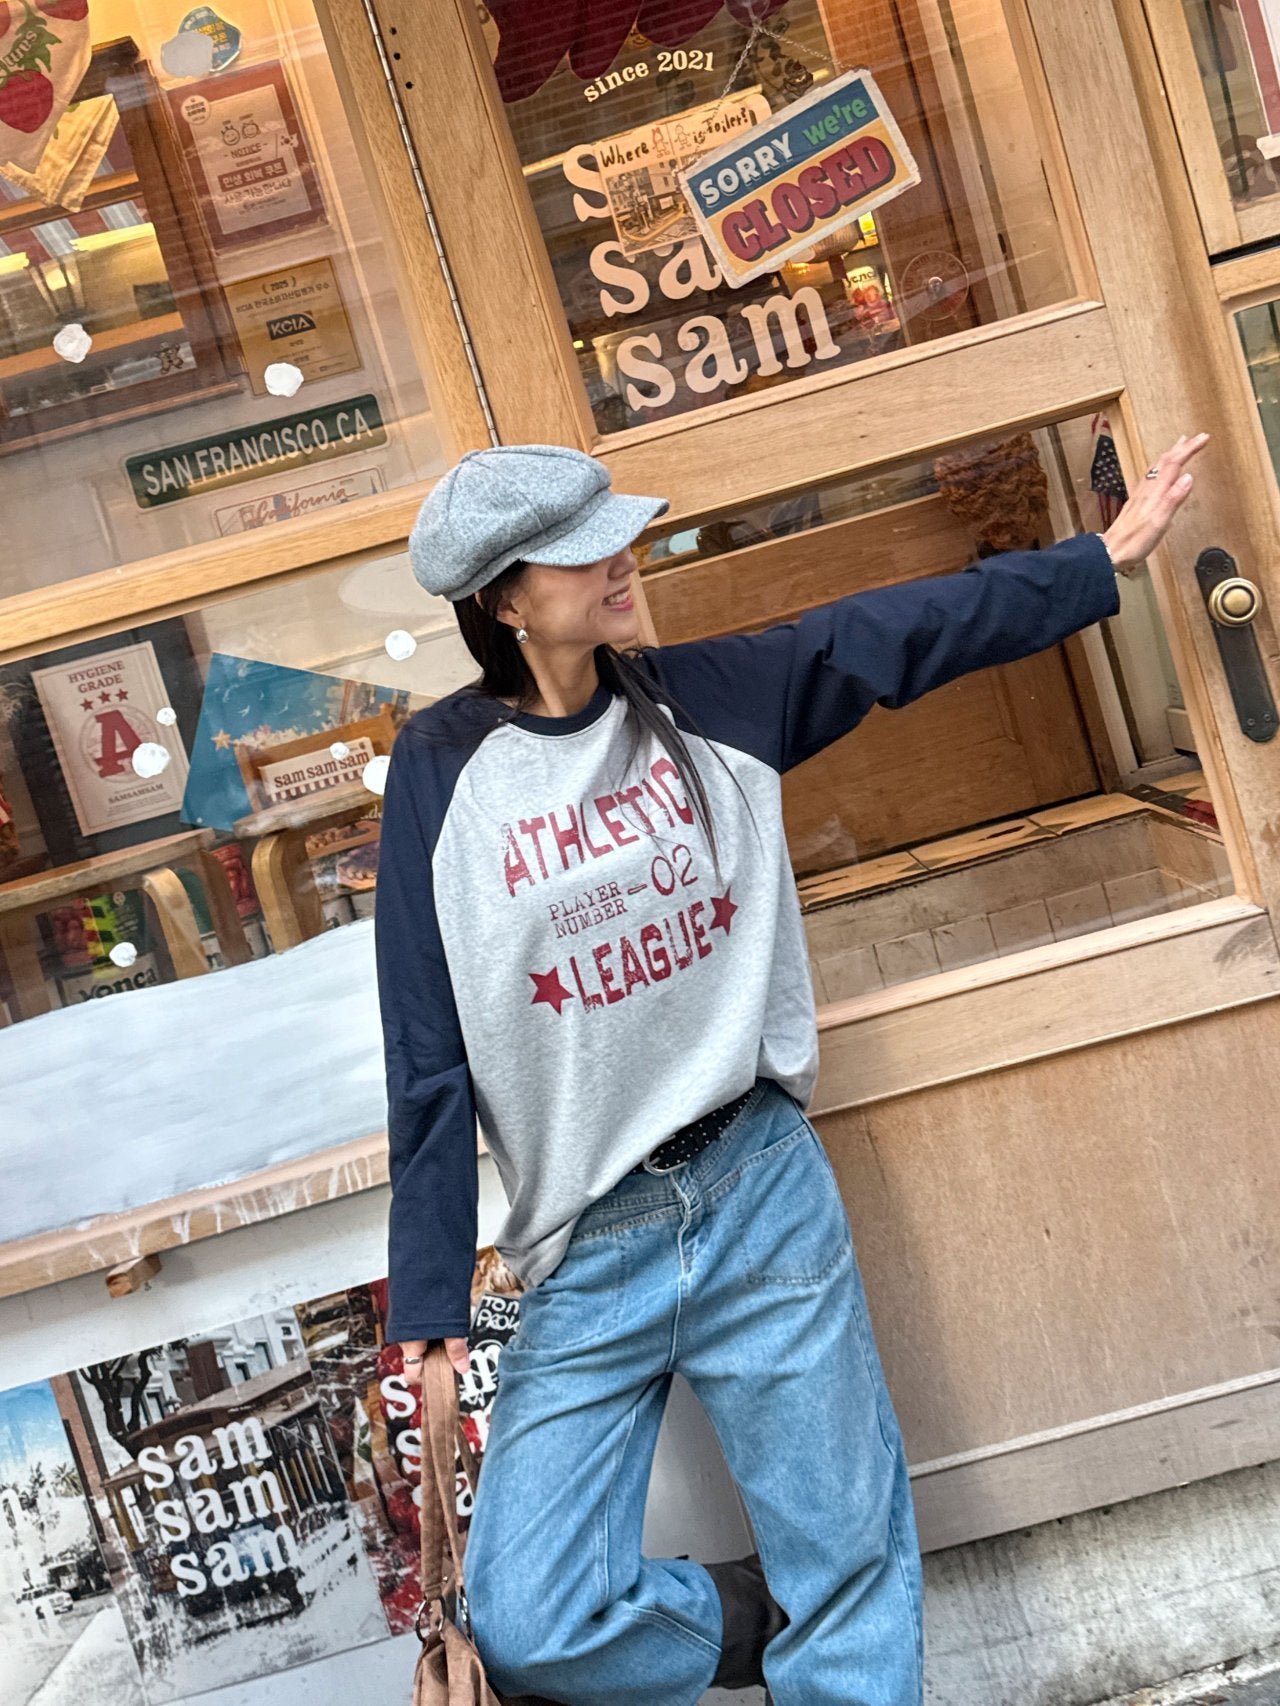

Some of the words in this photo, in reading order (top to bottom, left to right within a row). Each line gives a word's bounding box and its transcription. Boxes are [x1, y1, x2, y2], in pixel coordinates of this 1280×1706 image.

[583, 62, 649, 102] since
[656, 50, 714, 72] 2021
[230, 142, 262, 159] NOTICE
[600, 142, 650, 168] Where
[699, 132, 793, 208] SORRY
[802, 98, 868, 146] we're
[721, 136, 896, 262] CLOSED
[589, 238, 816, 318] sa
[269, 316, 312, 337] KCIA
[616, 286, 841, 412] sam
[142, 455, 194, 496] SAN
[196, 418, 337, 482] FRANCISCO,
[336, 408, 374, 443] CA
[253, 484, 359, 522] California
[67, 660, 125, 684] HYGIENE
[77, 674, 123, 694] GRADE
[94, 709, 143, 779] A
[107, 783, 164, 805] SAMSAMSAM
[502, 757, 695, 898] ATHLETIC
[547, 881, 622, 921] PLAYER
[554, 898, 629, 939] NUMBER
[569, 900, 713, 1014] LEAGUE
[137, 1416, 273, 1492] sam
[154, 1470, 289, 1544] sam
[170, 1524, 302, 1598] sam
